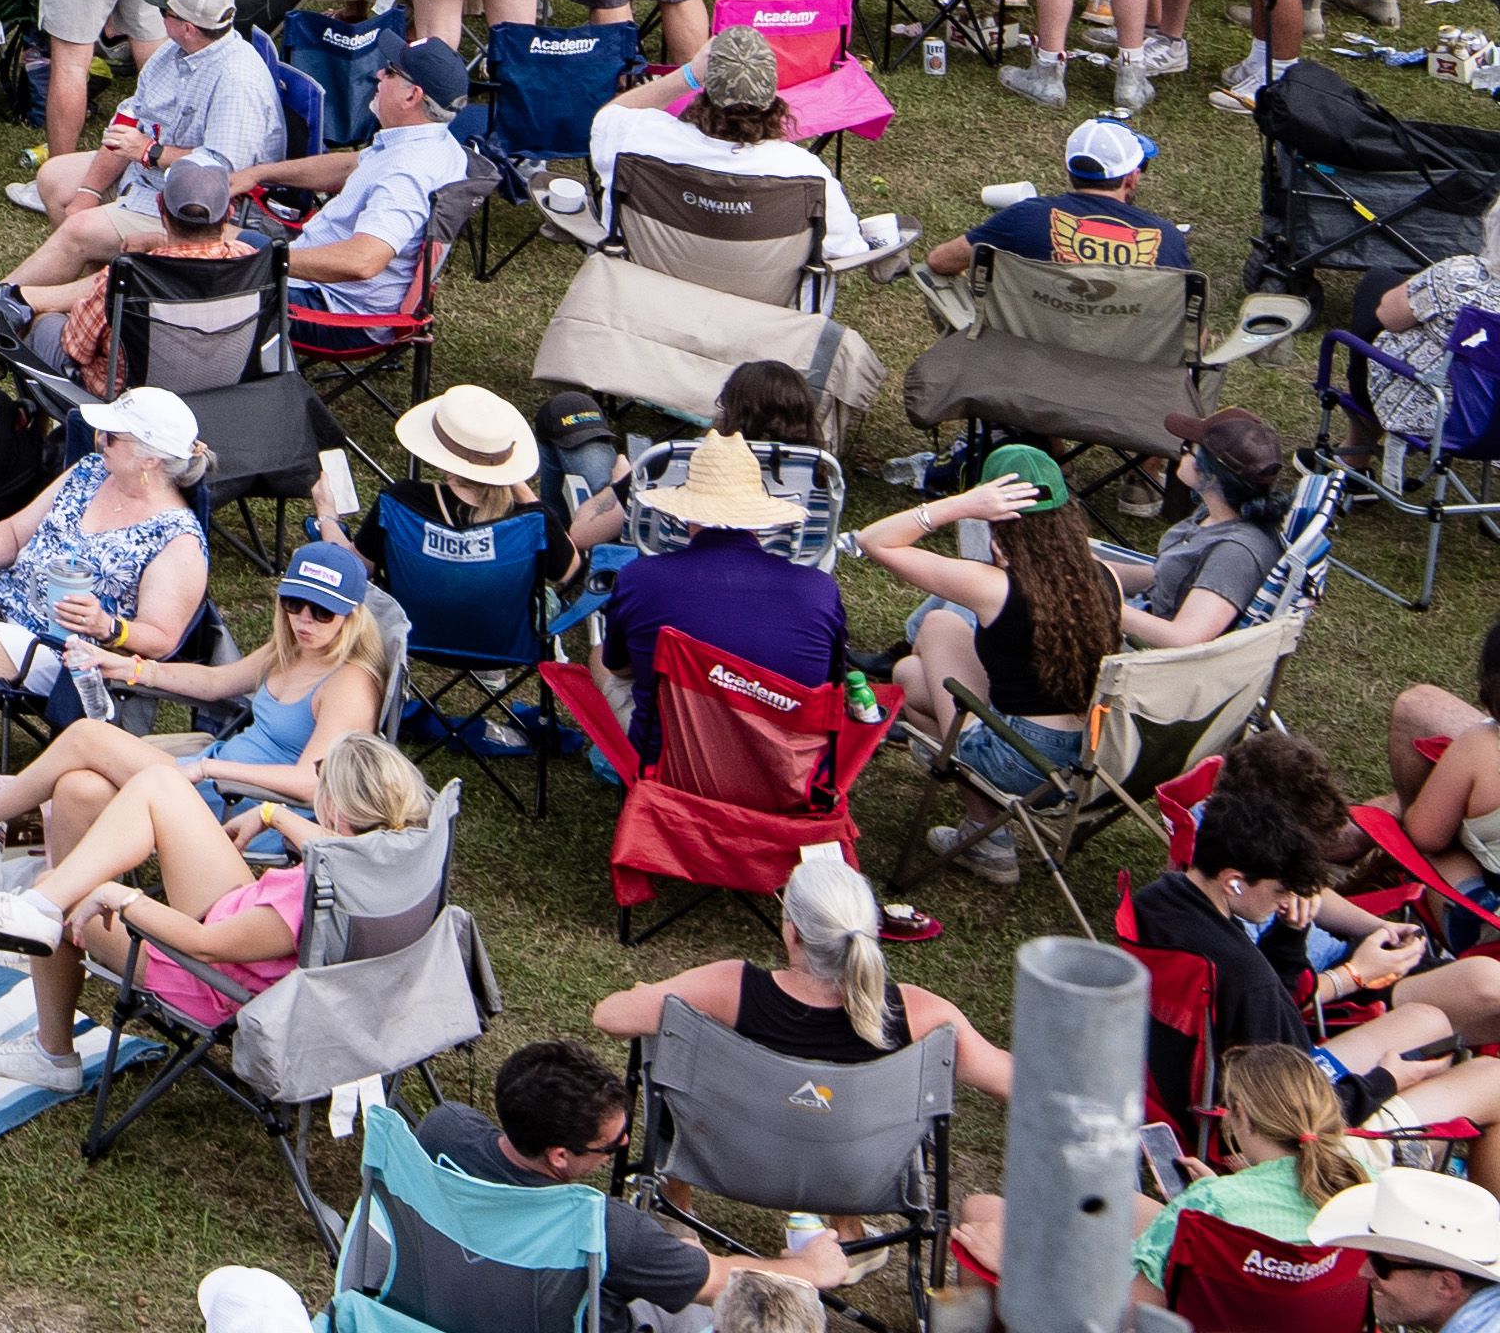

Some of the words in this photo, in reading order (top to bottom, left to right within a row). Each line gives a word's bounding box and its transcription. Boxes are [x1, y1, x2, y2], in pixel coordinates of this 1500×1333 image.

[752, 10, 819, 27] Academy
[323, 27, 381, 49] Academy
[530, 37, 600, 53] Academy
[698, 195, 752, 211] MAGELLAN
[1078, 237, 1131, 266] 610
[1032, 289, 1097, 316] MOSSY
[1099, 303, 1142, 316] OAK
[708, 664, 802, 711] Academy
[1244, 1248, 1340, 1278] Academy
